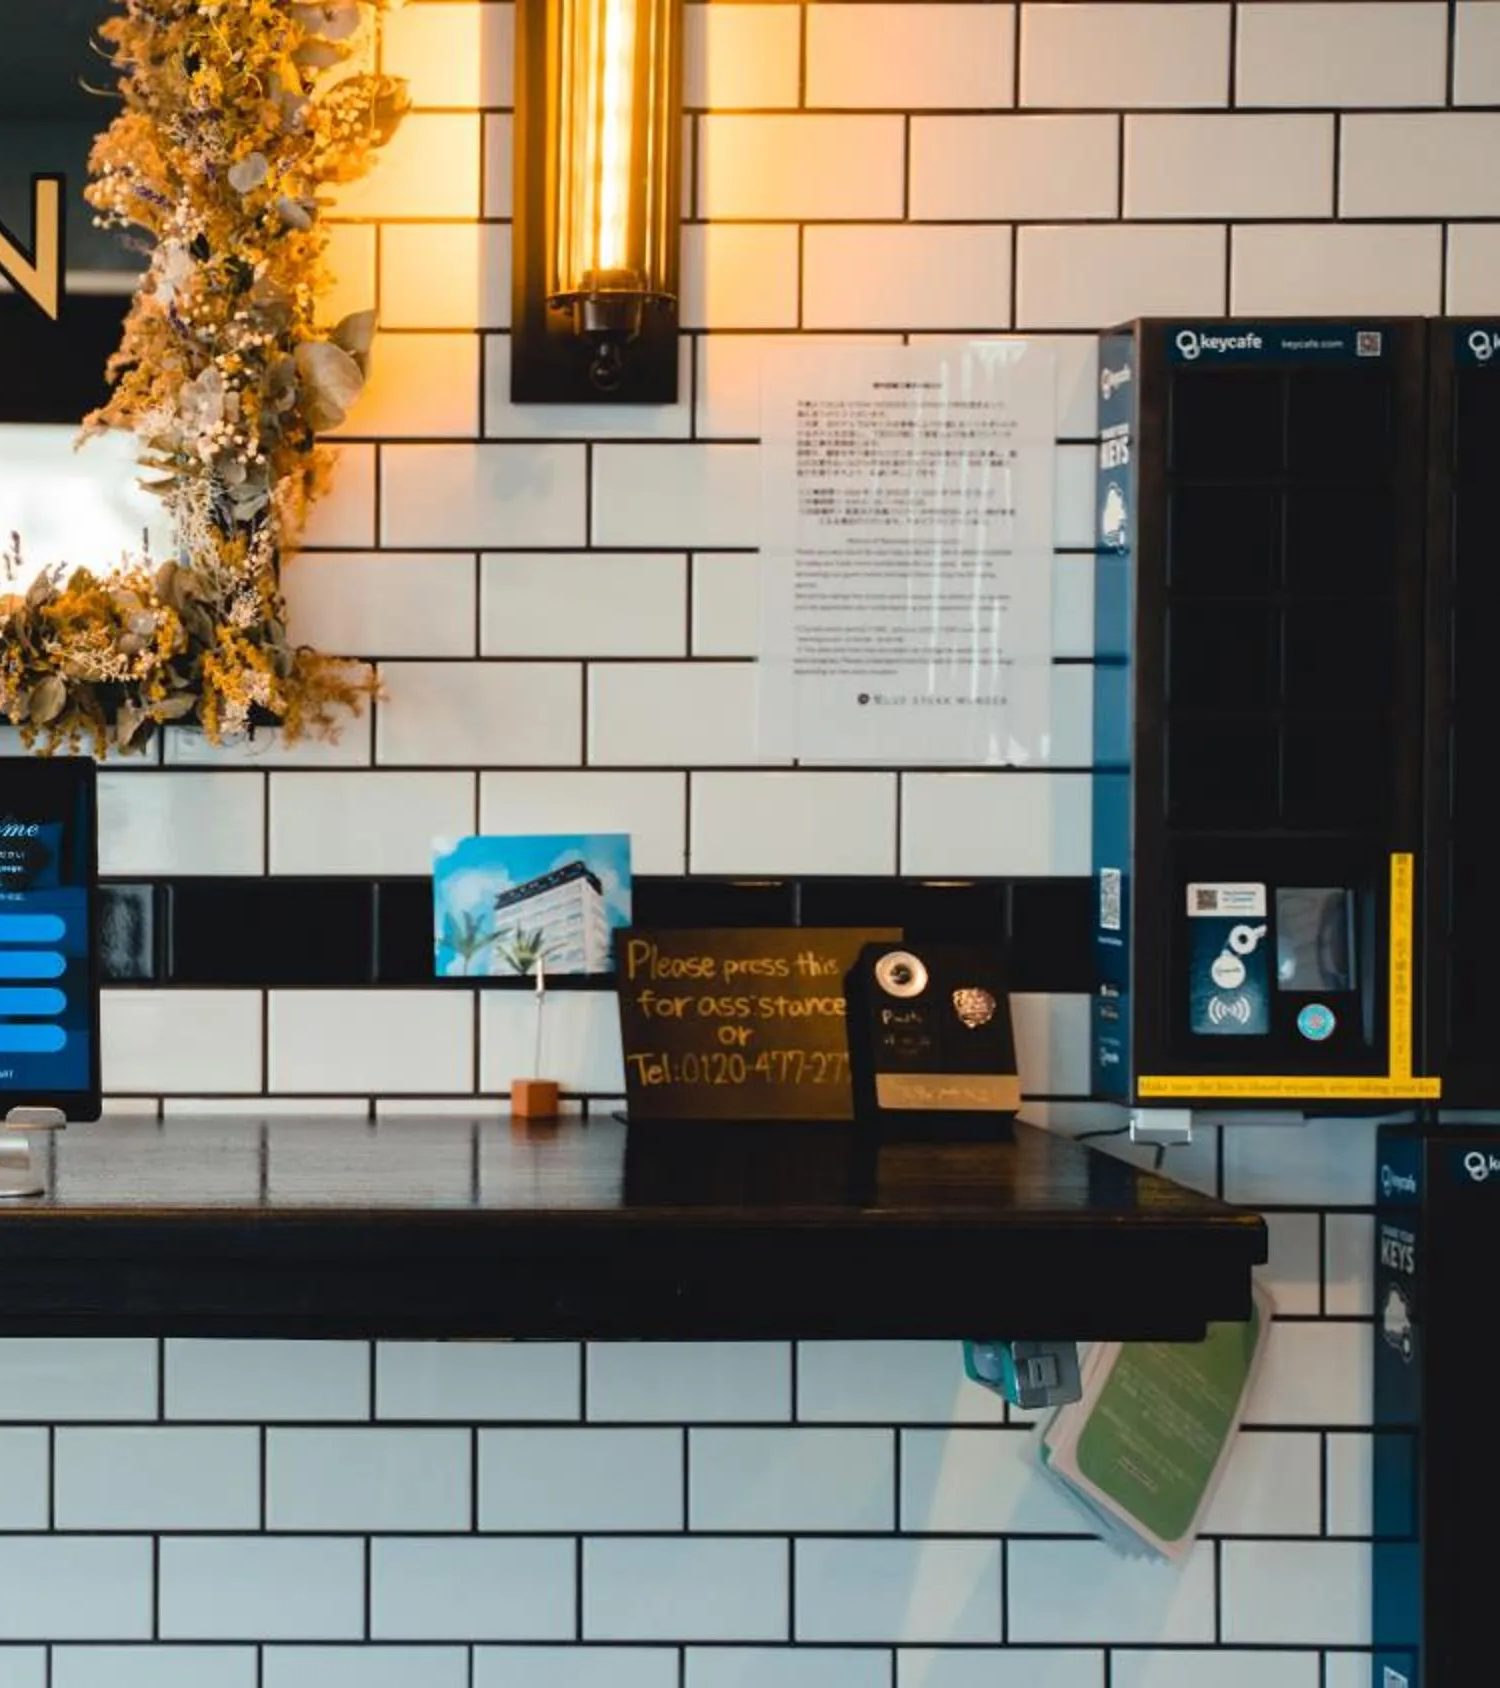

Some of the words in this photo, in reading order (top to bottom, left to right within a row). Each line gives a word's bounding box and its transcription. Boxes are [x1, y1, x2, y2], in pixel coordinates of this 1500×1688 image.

[1201, 332, 1262, 352] keycafe
[627, 938, 716, 980] Please
[723, 957, 790, 985] press
[793, 950, 840, 976] this
[637, 990, 693, 1019] for
[717, 1024, 754, 1047] or
[1381, 1237, 1415, 1275] KEYS
